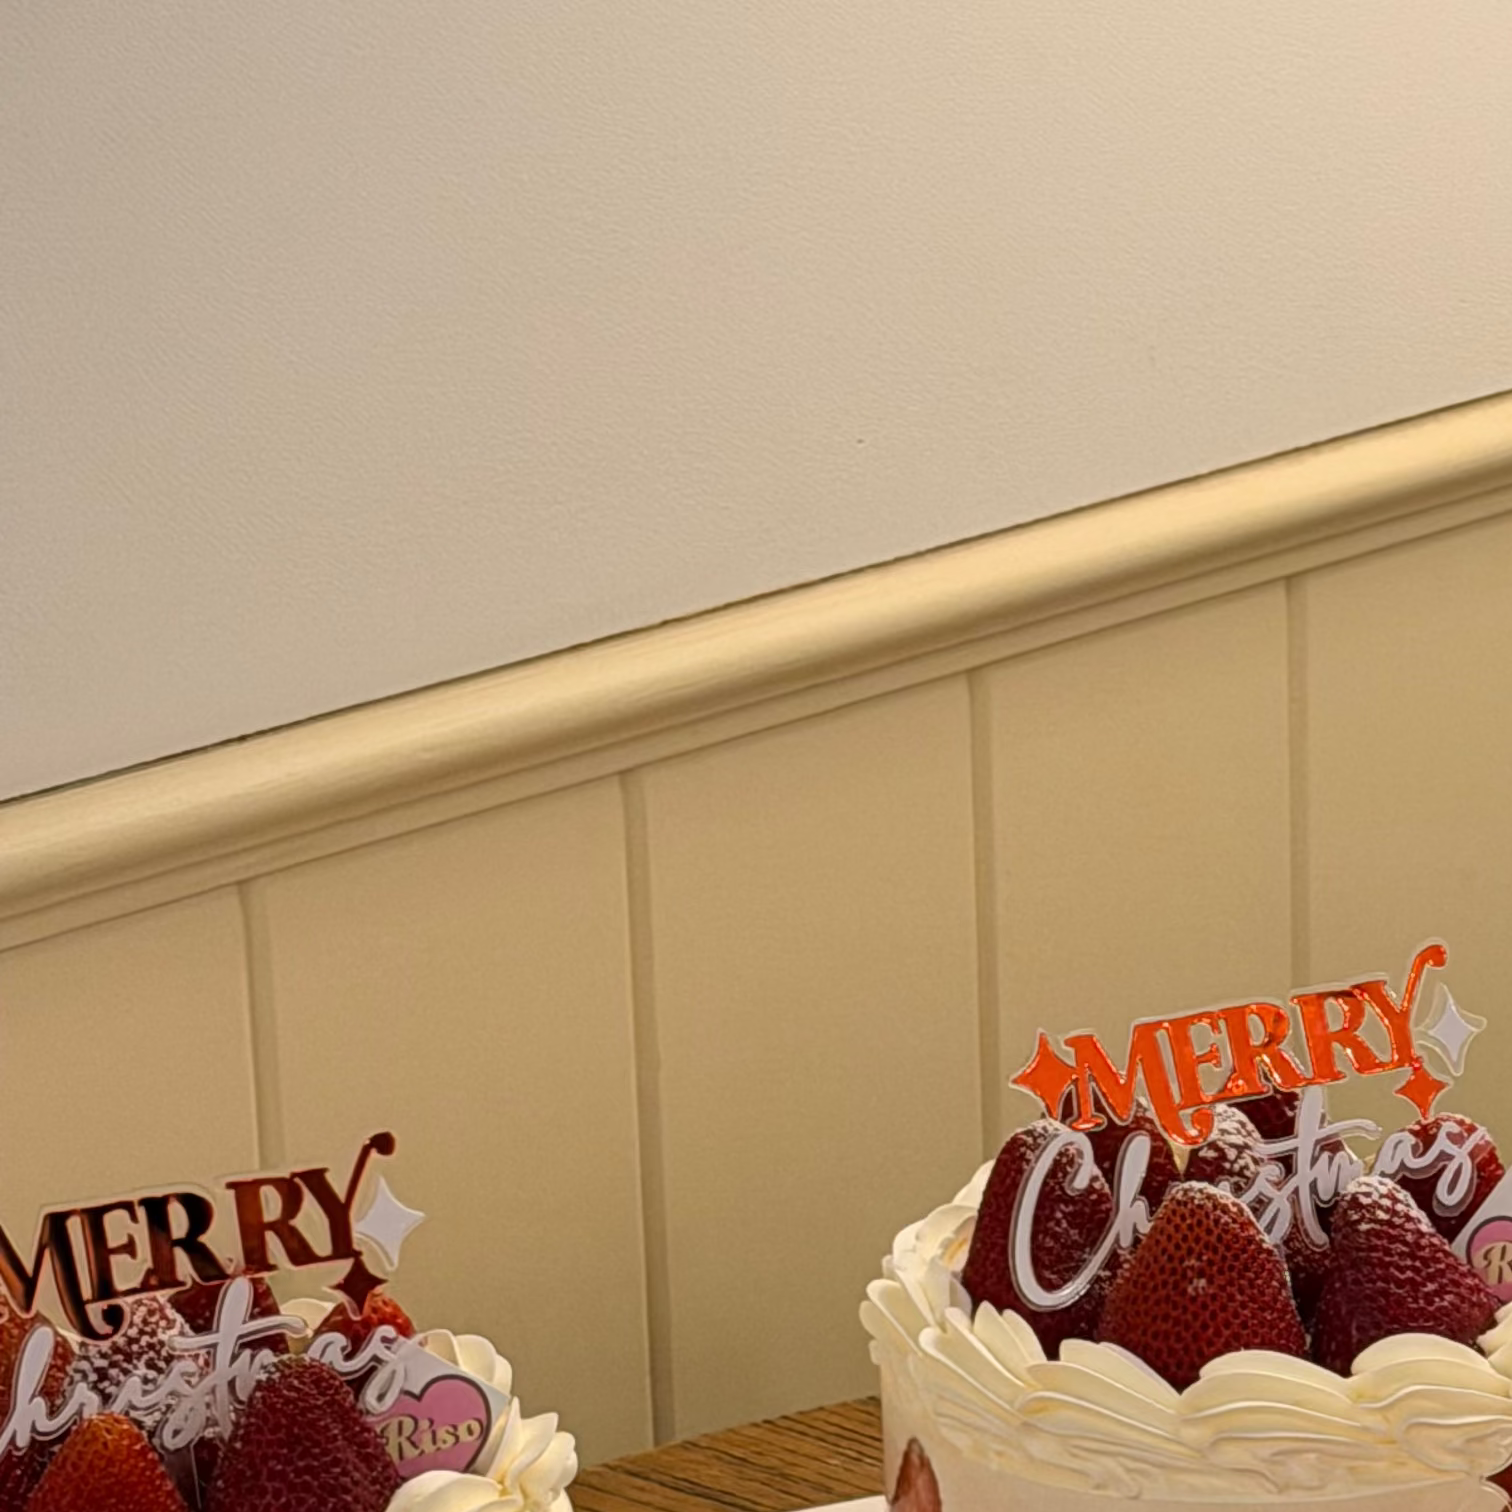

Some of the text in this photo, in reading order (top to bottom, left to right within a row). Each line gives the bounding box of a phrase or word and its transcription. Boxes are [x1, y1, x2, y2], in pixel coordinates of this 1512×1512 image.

[1064, 943, 1449, 1146] MERRY
[0, 1131, 396, 1341] MERRY
[1009, 1086, 1489, 1311] Chstmas
[0, 1275, 418, 1451] hristas
[377, 1413, 484, 1466] Riso
